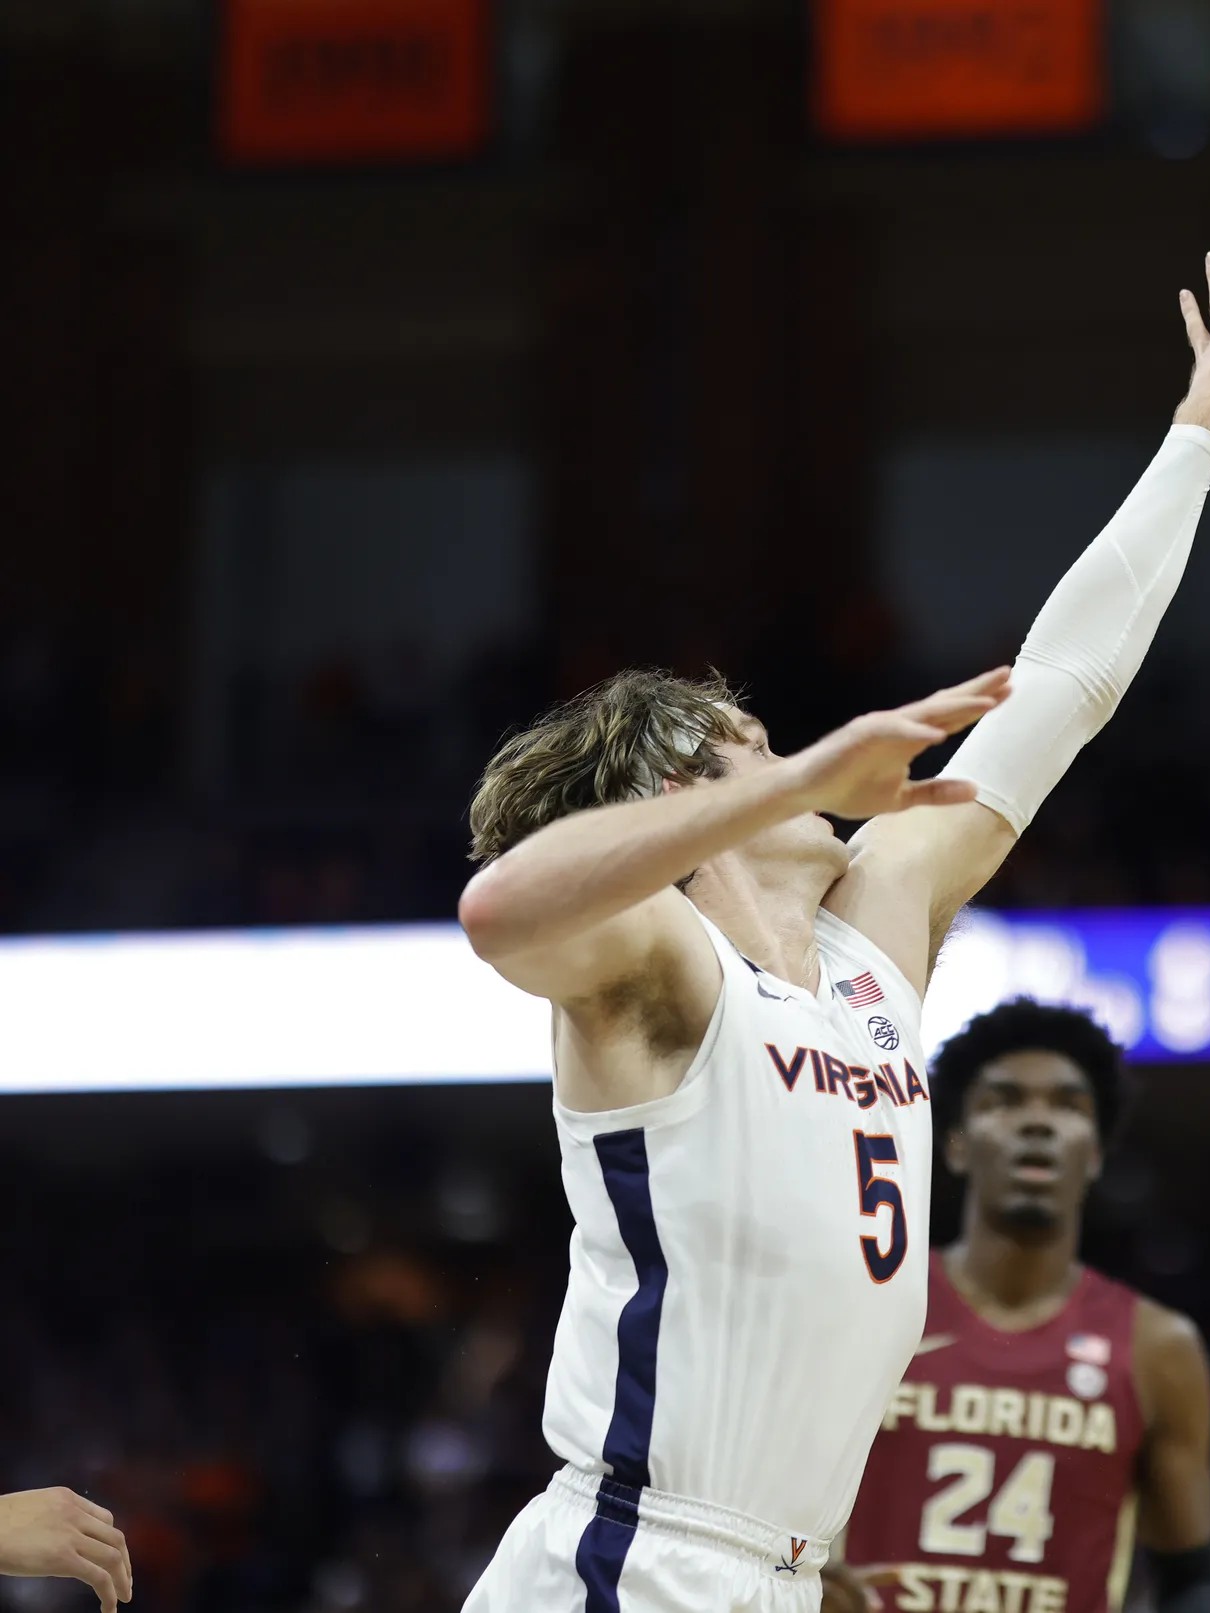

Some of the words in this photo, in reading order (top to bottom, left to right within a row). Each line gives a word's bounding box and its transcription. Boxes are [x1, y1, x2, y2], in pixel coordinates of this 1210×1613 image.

[874, 1024, 895, 1036] ACC
[764, 1042, 930, 1110] VIRGNIA
[852, 1129, 908, 1284] 5
[880, 1381, 1117, 1454] FLORIDA
[918, 1442, 1056, 1564] 24
[895, 1562, 1069, 1613] STATE
